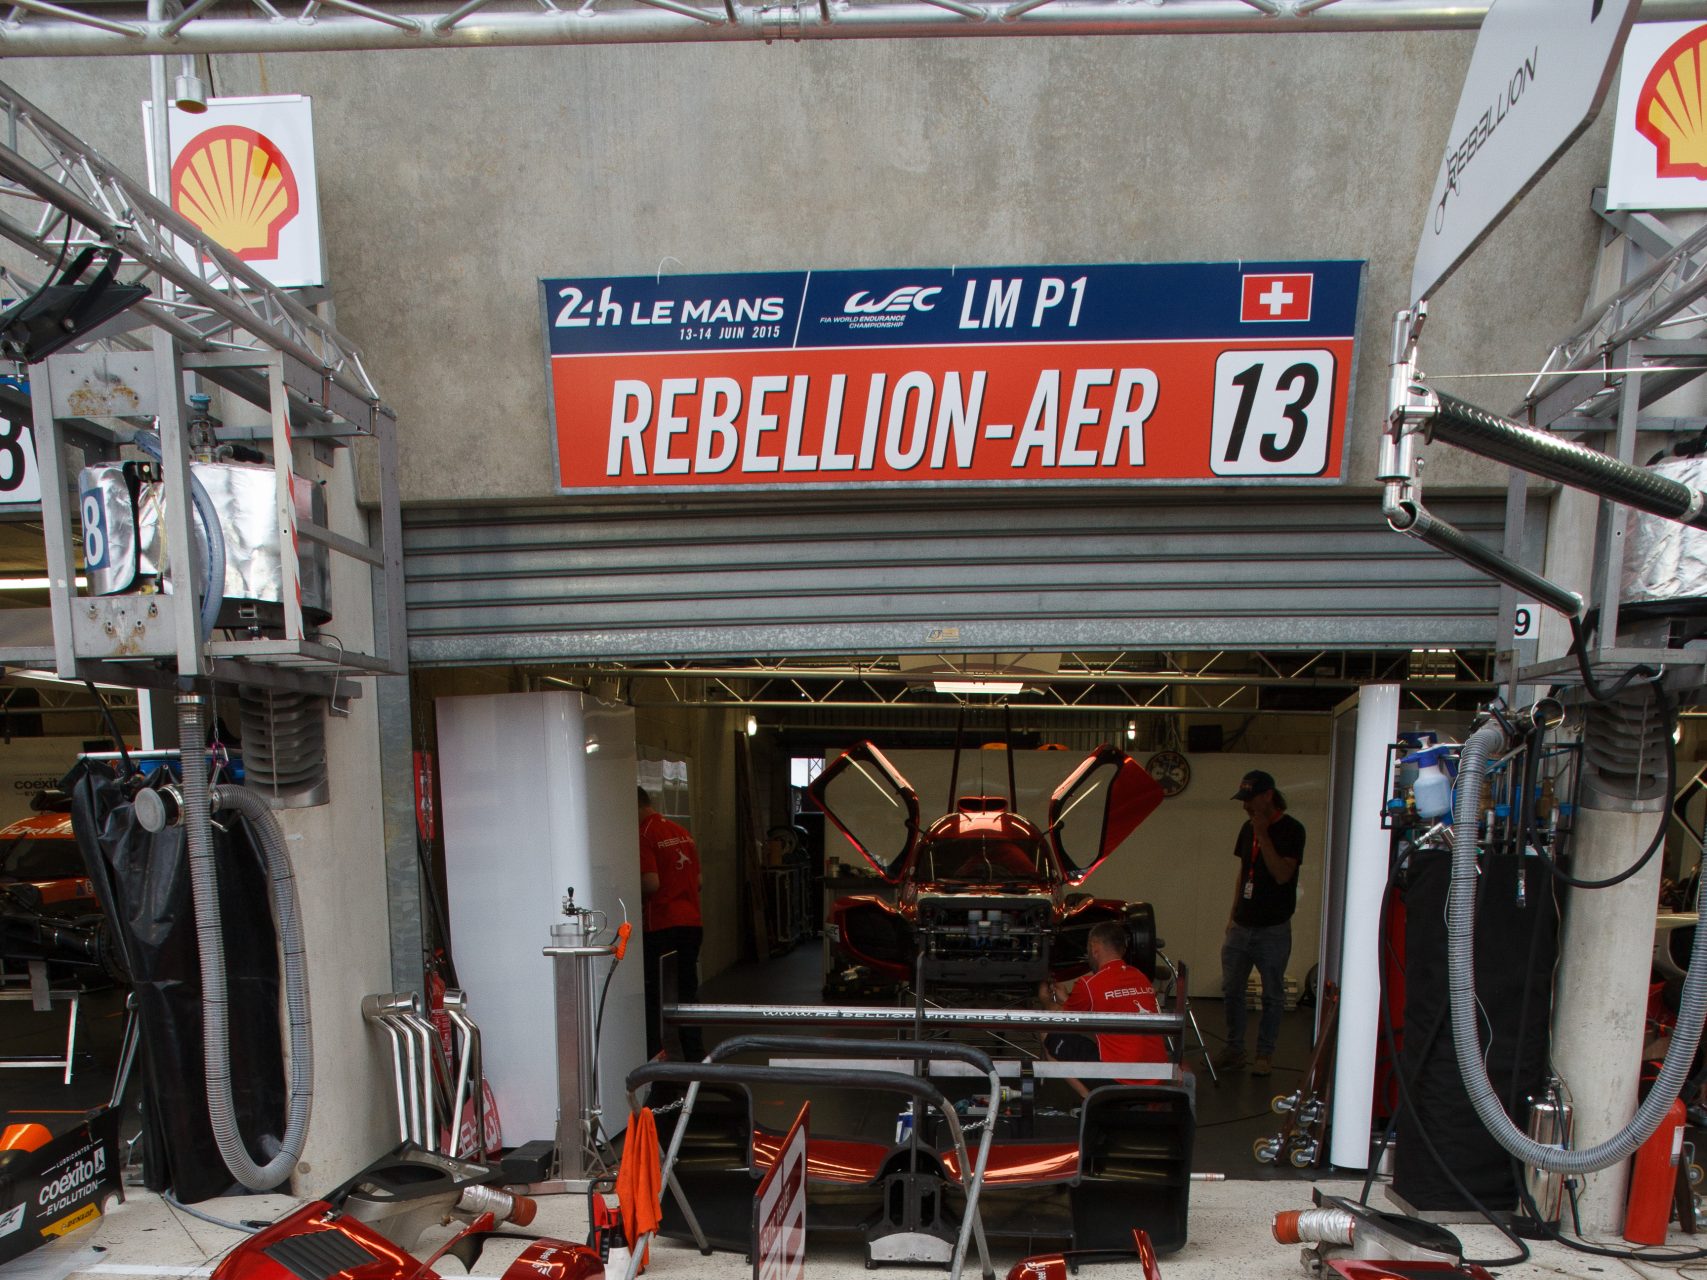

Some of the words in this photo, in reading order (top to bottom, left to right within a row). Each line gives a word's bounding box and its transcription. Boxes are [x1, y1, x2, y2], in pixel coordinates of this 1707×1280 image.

[631, 300, 675, 325] LE
[680, 297, 784, 323] MANS
[843, 286, 943, 314] WEC
[959, 278, 1023, 329] LM
[1032, 276, 1088, 328] P1
[680, 328, 712, 341] 13-14
[719, 326, 745, 340] JUIN
[752, 325, 781, 338] 2015
[848, 321, 904, 329] CHAMPIONSHIP
[859, 314, 906, 322] ENDURANCE
[606, 367, 1158, 476] REBELLION-AER
[1223, 362, 1320, 462] 13
[84, 495, 104, 568] 8
[1104, 986, 1155, 1000] REBELLIO
[39, 1160, 94, 1205] coéxito
[47, 1180, 99, 1216] EVOLUTION
